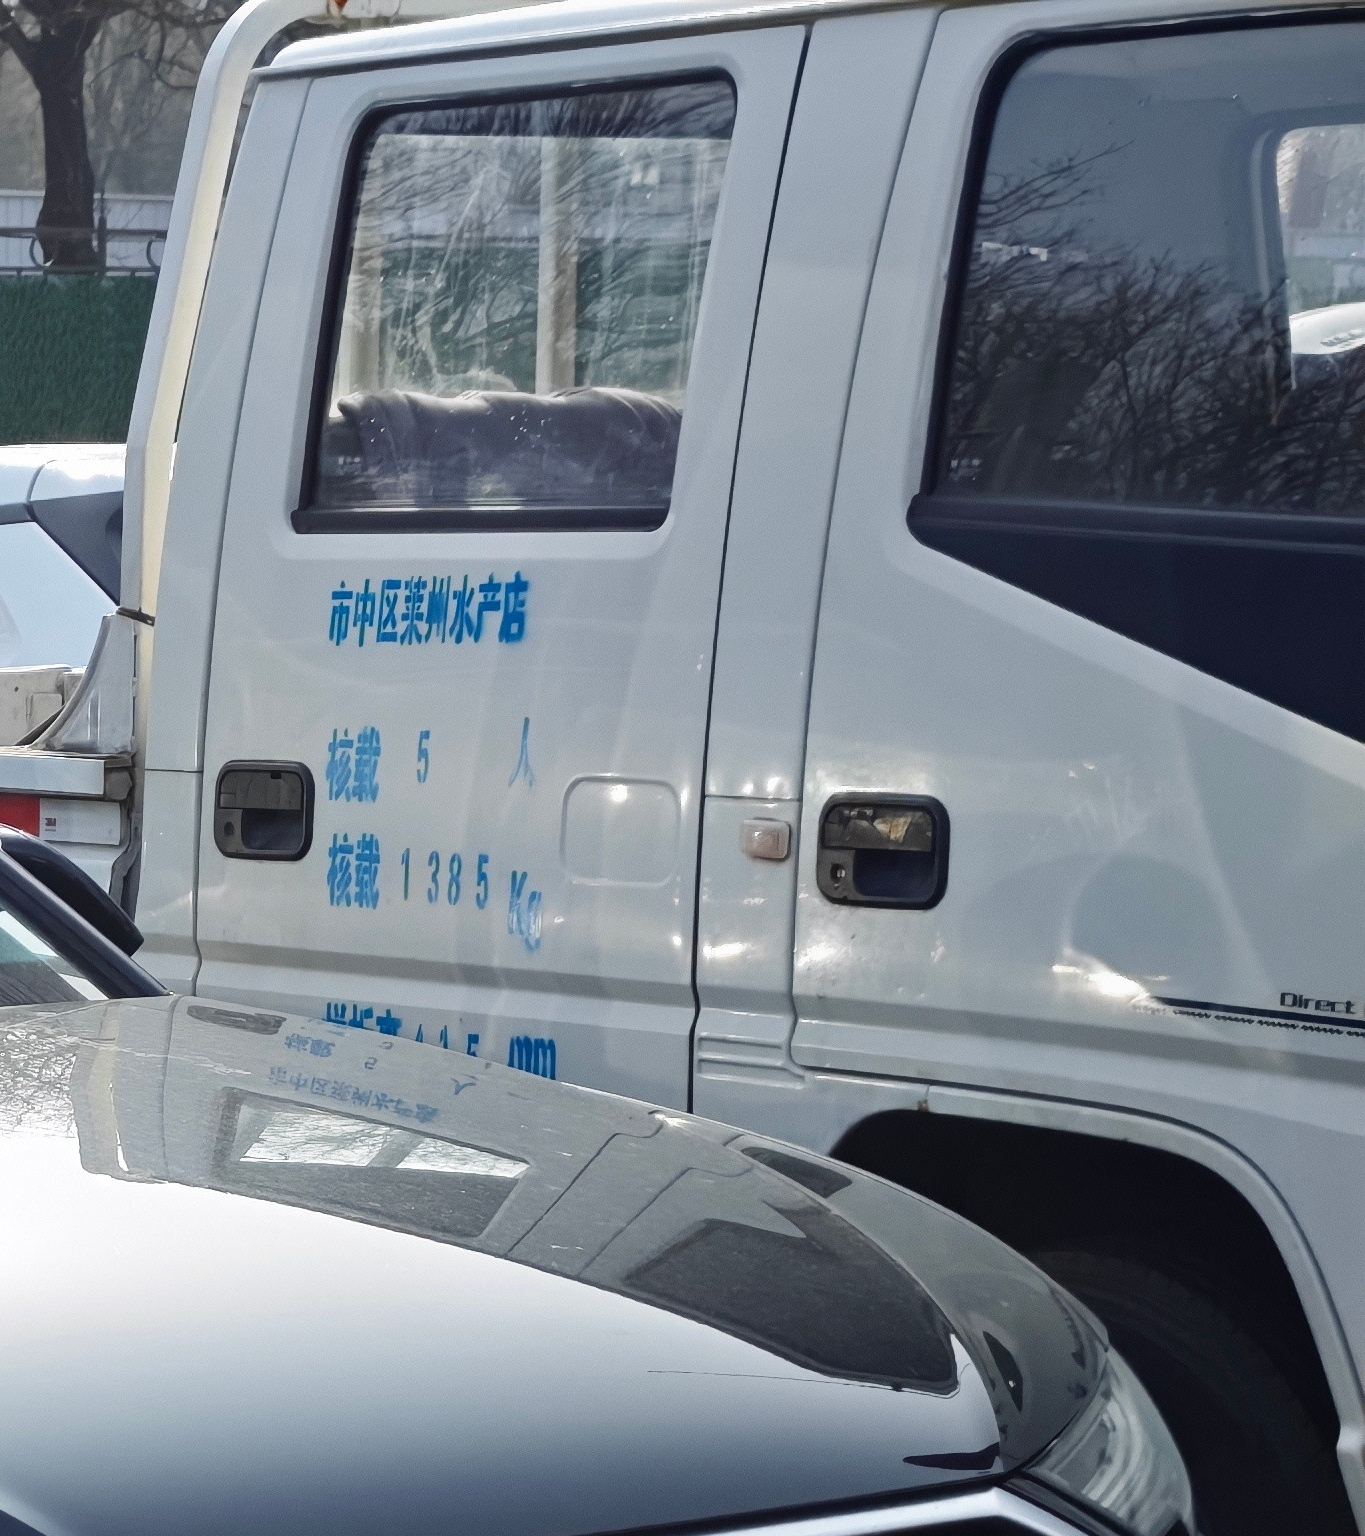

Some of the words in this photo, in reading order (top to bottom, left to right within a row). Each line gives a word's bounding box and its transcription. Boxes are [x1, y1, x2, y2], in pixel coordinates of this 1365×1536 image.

[328, 570, 529, 647] 市中区莱州水产店
[326, 726, 381, 803] 核载
[417, 730, 430, 783] 5
[508, 716, 537, 789] 人
[327, 833, 380, 909] 核载
[401, 847, 489, 910] 1385
